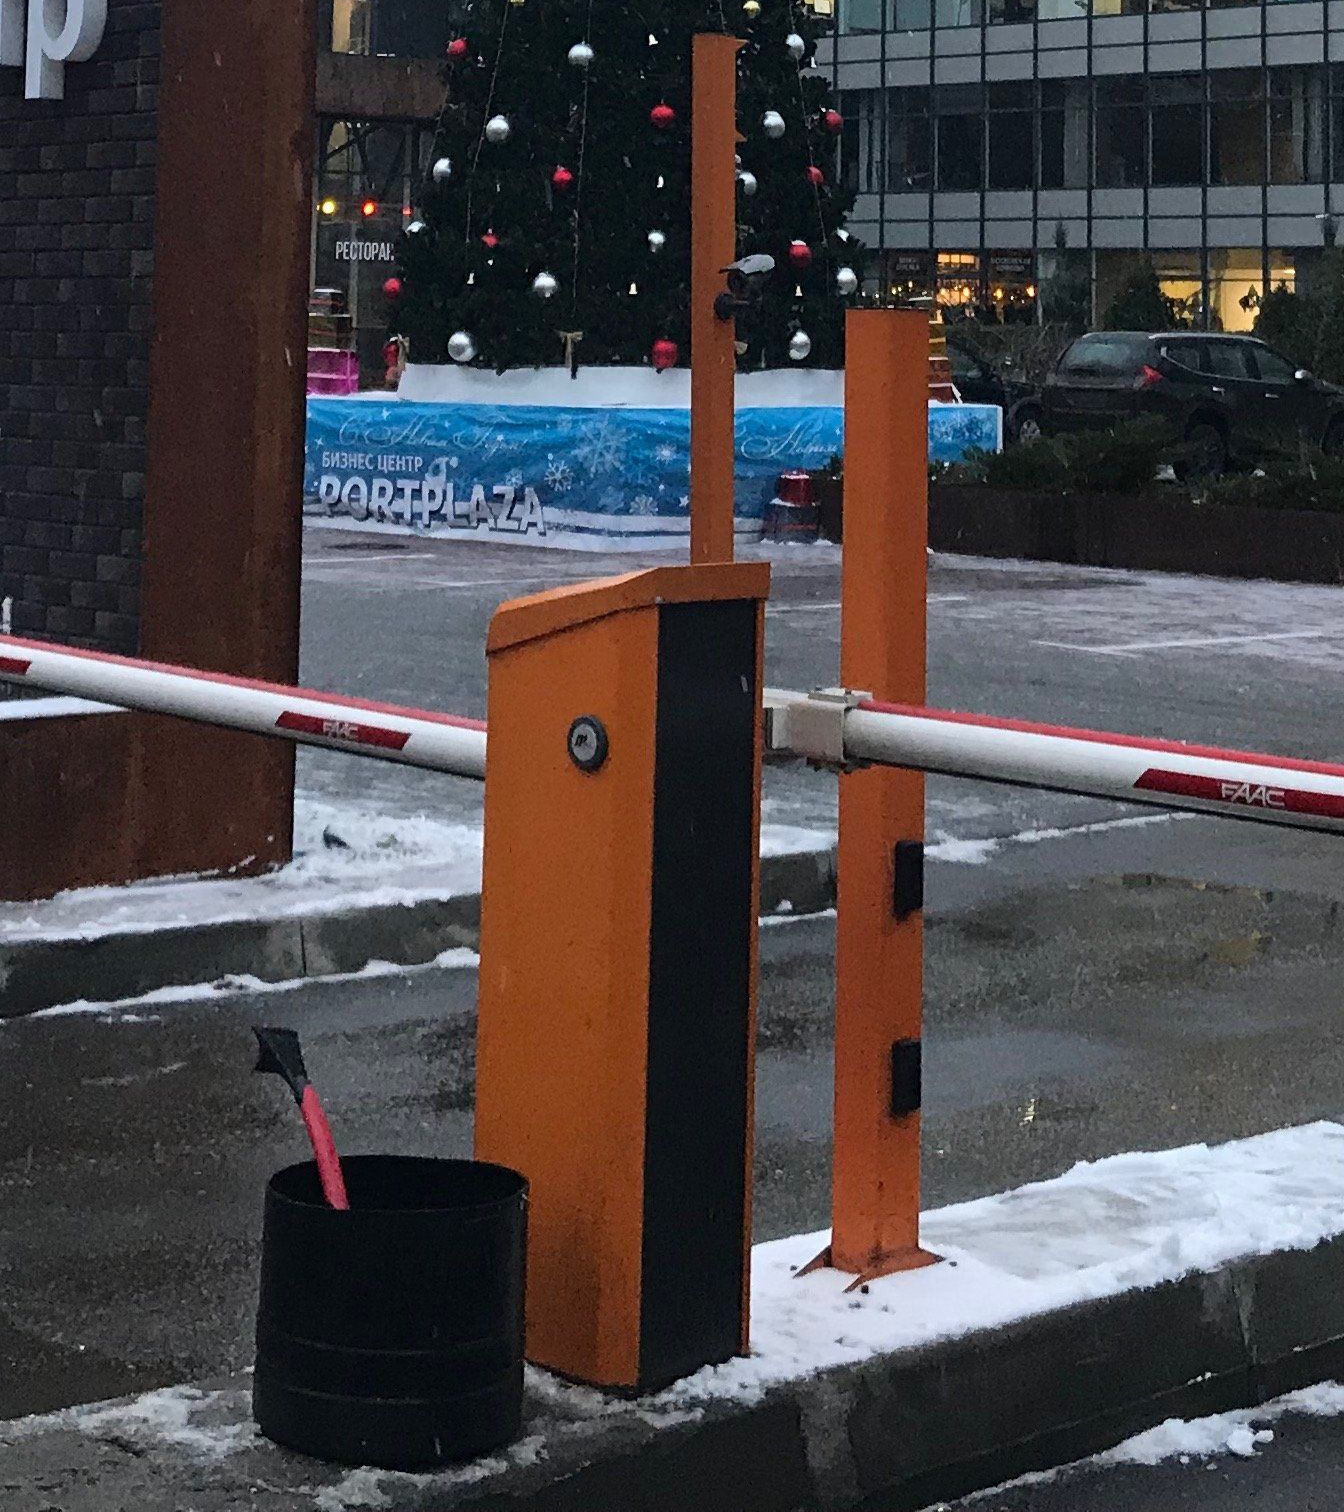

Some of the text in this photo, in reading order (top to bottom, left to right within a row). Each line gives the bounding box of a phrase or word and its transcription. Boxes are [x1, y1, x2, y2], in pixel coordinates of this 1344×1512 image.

[322, 451, 423, 473] БИЗНЕС ЦЕНТР
[319, 473, 546, 536] PORTPLAZA
[1221, 782, 1286, 807] FAAC
